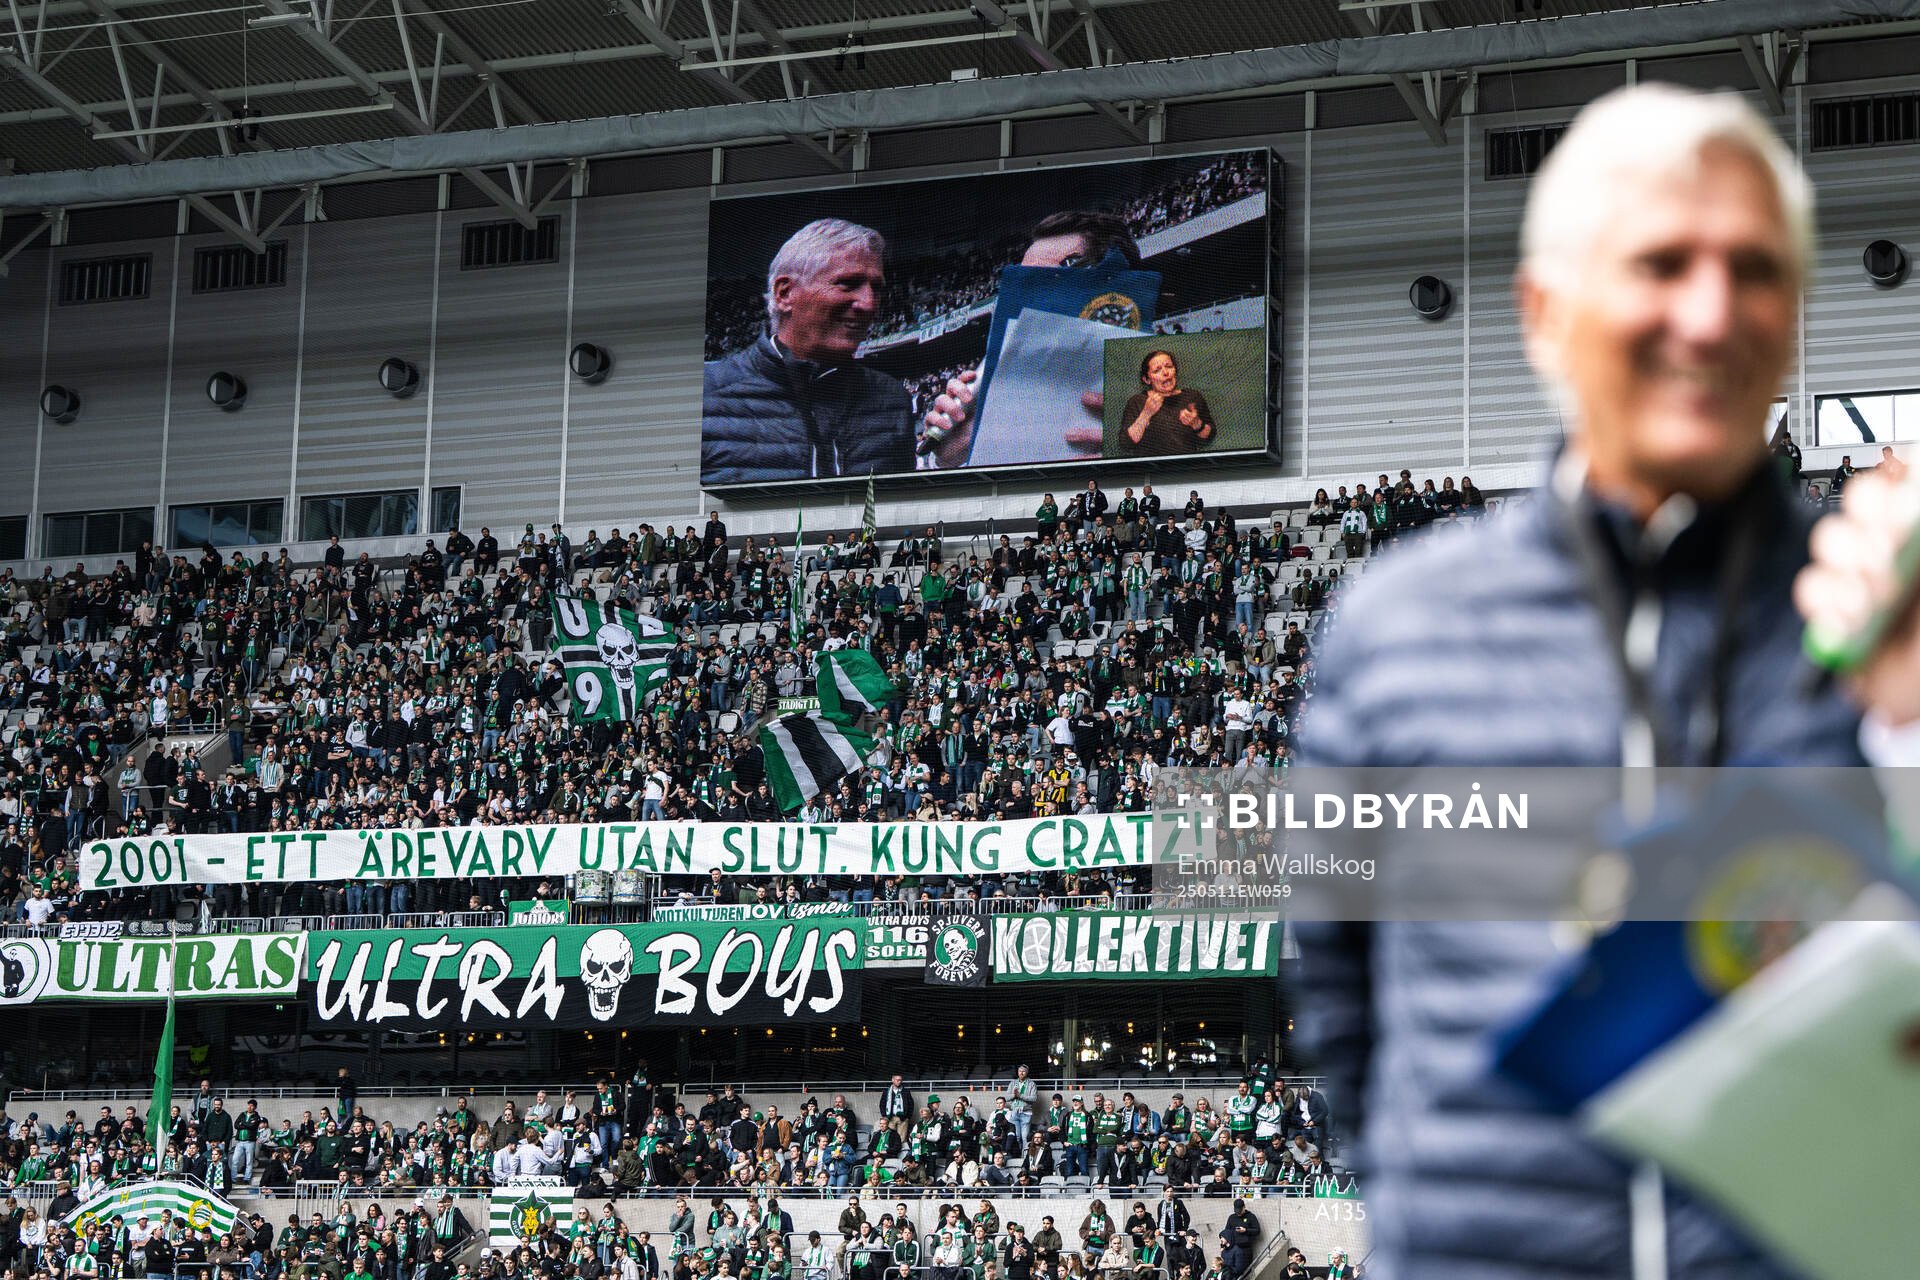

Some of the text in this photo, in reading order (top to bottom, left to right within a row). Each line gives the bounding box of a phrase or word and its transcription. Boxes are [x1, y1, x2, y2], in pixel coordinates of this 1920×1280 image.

[91, 838, 188, 887] 2001
[246, 833, 327, 880] ETT
[356, 828, 556, 877] ÄREVARV
[579, 825, 695, 873] UTAN
[721, 825, 847, 873] SLUT.
[870, 823, 1001, 873] KUNG
[1026, 811, 1203, 868] CRATZ!
[511, 910, 567, 925] JUNIORS
[655, 906, 744, 922] MOTKULTUREN
[901, 914, 931, 925] BOYS
[867, 926, 929, 944] 116
[931, 914, 986, 941] SPJUVERN
[867, 944, 927, 958] SOFIA
[995, 911, 1279, 975] KOLLEKTIVET
[57, 936, 296, 993] ULTRAS
[316, 924, 857, 1022] ULTRA BOYS
[929, 959, 980, 982] FOREVER
[1314, 1202, 1367, 1221] A135
